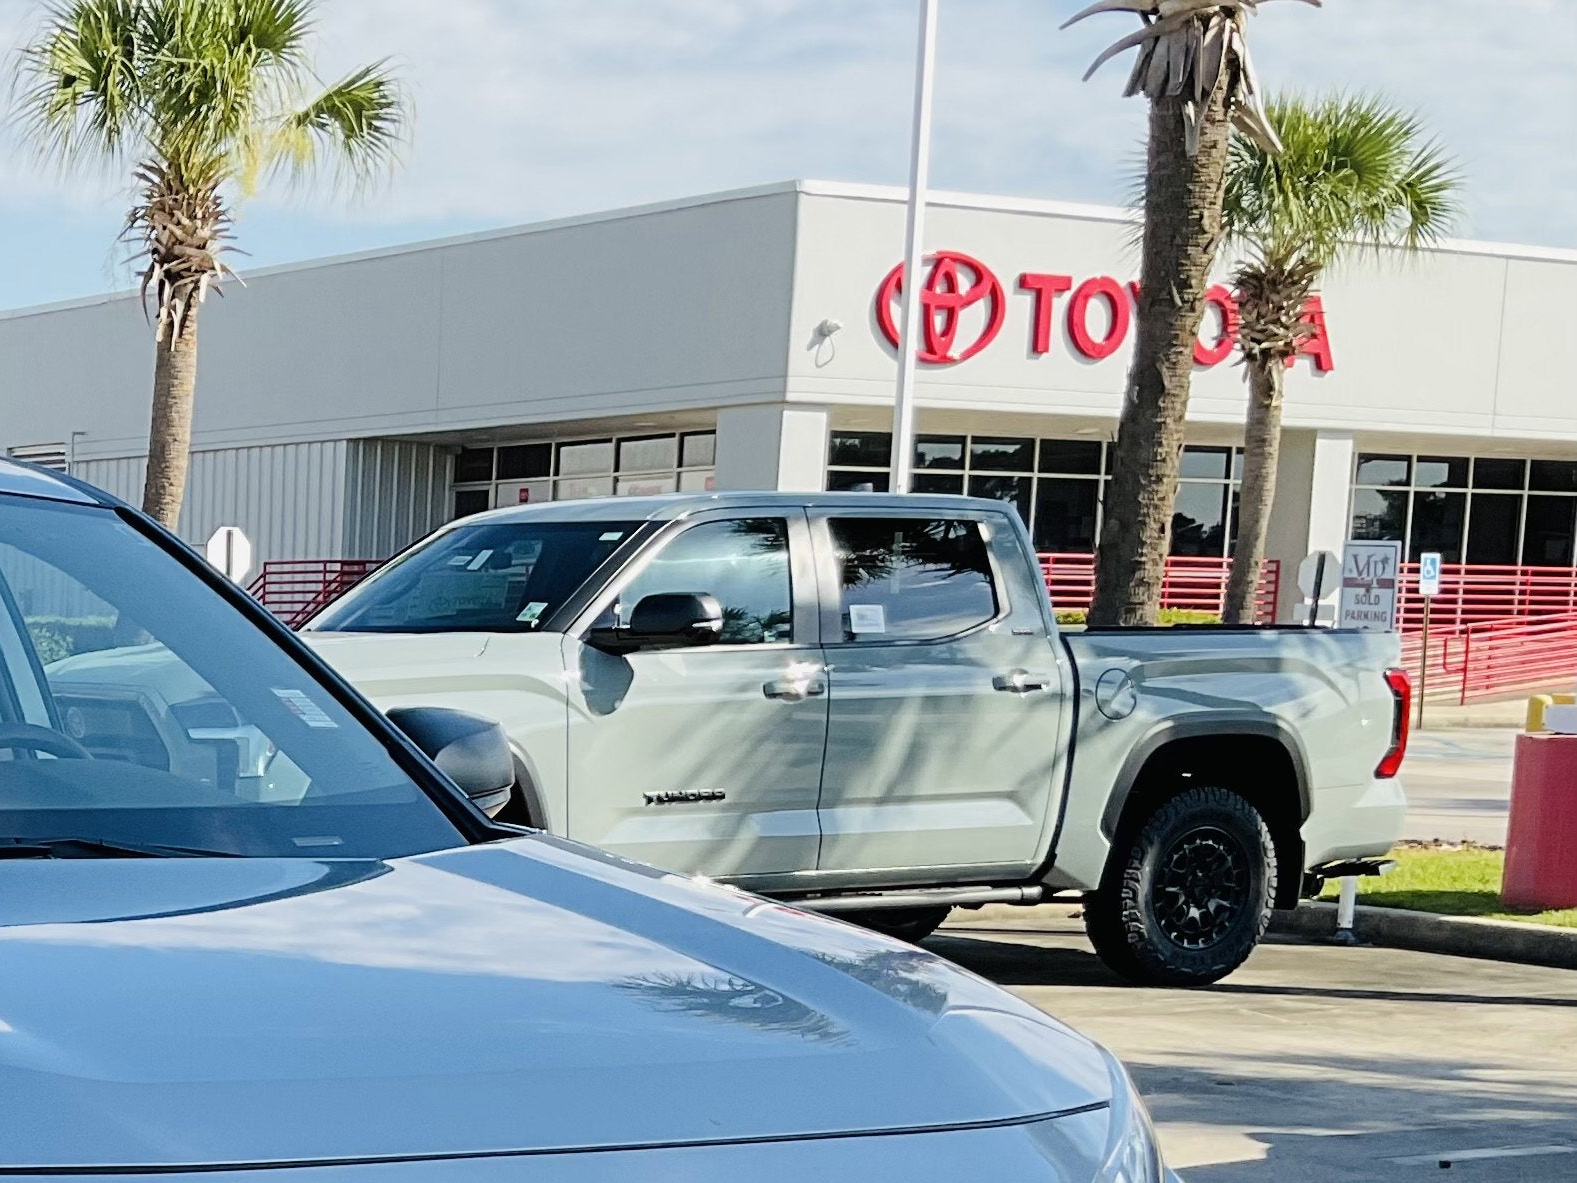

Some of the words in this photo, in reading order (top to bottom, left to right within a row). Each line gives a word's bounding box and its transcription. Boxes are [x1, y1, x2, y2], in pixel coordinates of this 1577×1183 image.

[1020, 273, 1334, 371] TOOA
[1354, 594, 1380, 606] SOLD
[1344, 609, 1388, 622] PARKING
